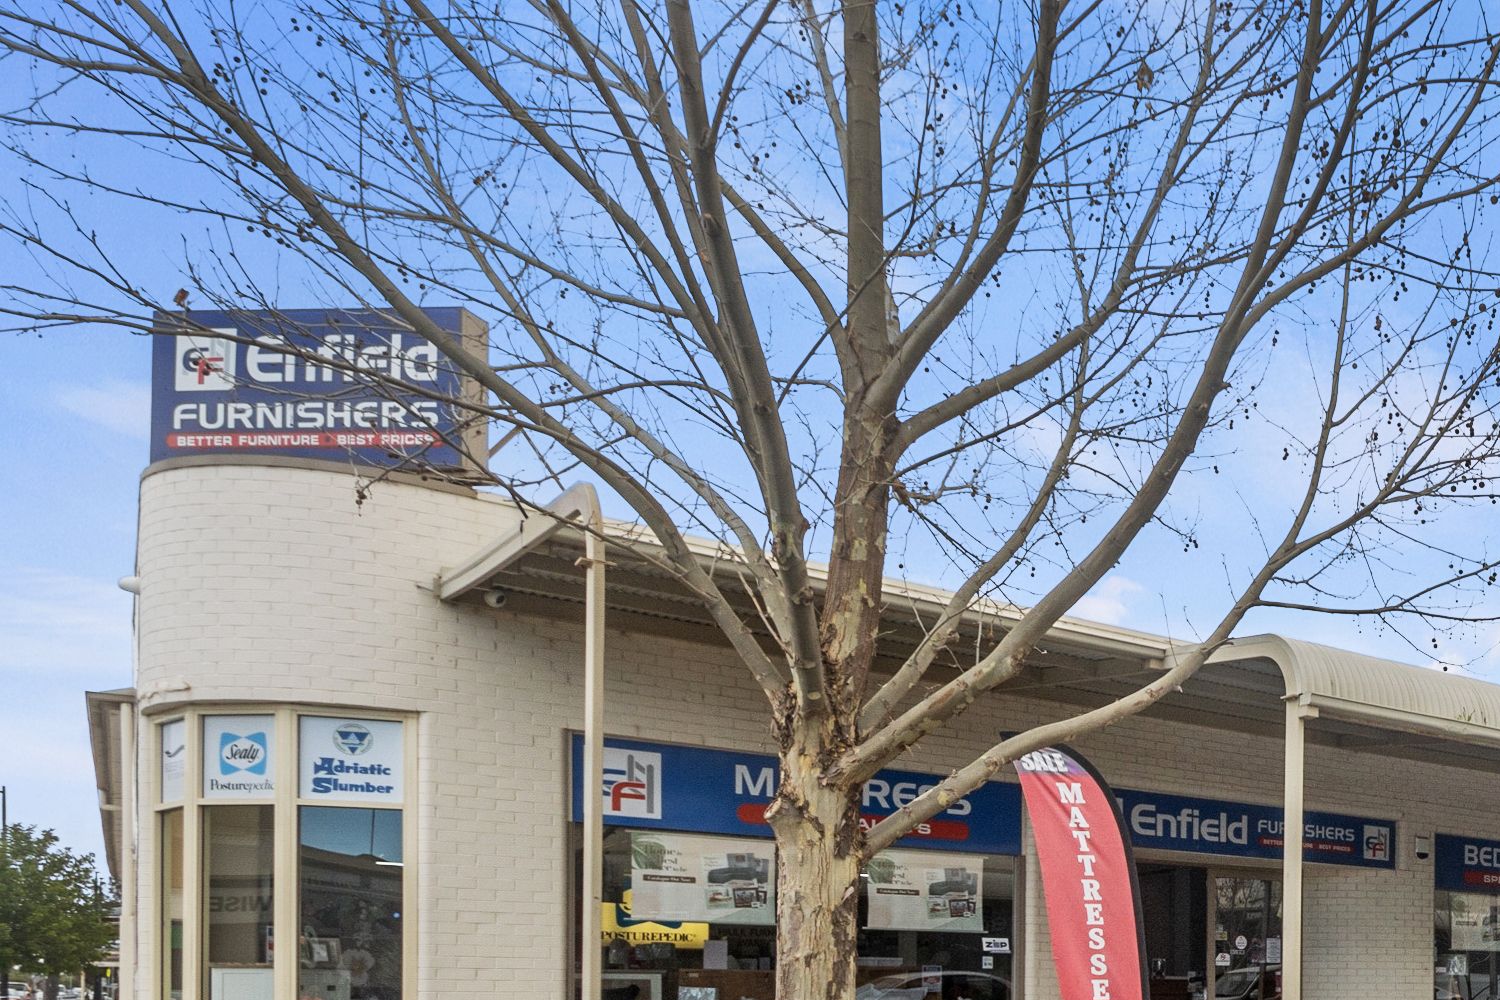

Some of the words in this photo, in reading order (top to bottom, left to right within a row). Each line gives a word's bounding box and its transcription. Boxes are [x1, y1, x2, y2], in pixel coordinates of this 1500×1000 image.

[246, 334, 438, 382] Enfield
[173, 401, 439, 430] FURNISHERS
[177, 435, 233, 447] BETTER
[239, 435, 320, 447] FURNITURE
[337, 434, 375, 446] BEST
[381, 434, 434, 446] PRICES
[225, 743, 260, 763] Sealy
[1020, 750, 1069, 773] SALE
[313, 757, 392, 776] Adriatic
[311, 777, 394, 795] Slumber
[1130, 803, 1248, 845] Enfield
[601, 930, 695, 942] POSTUREPEDIC
